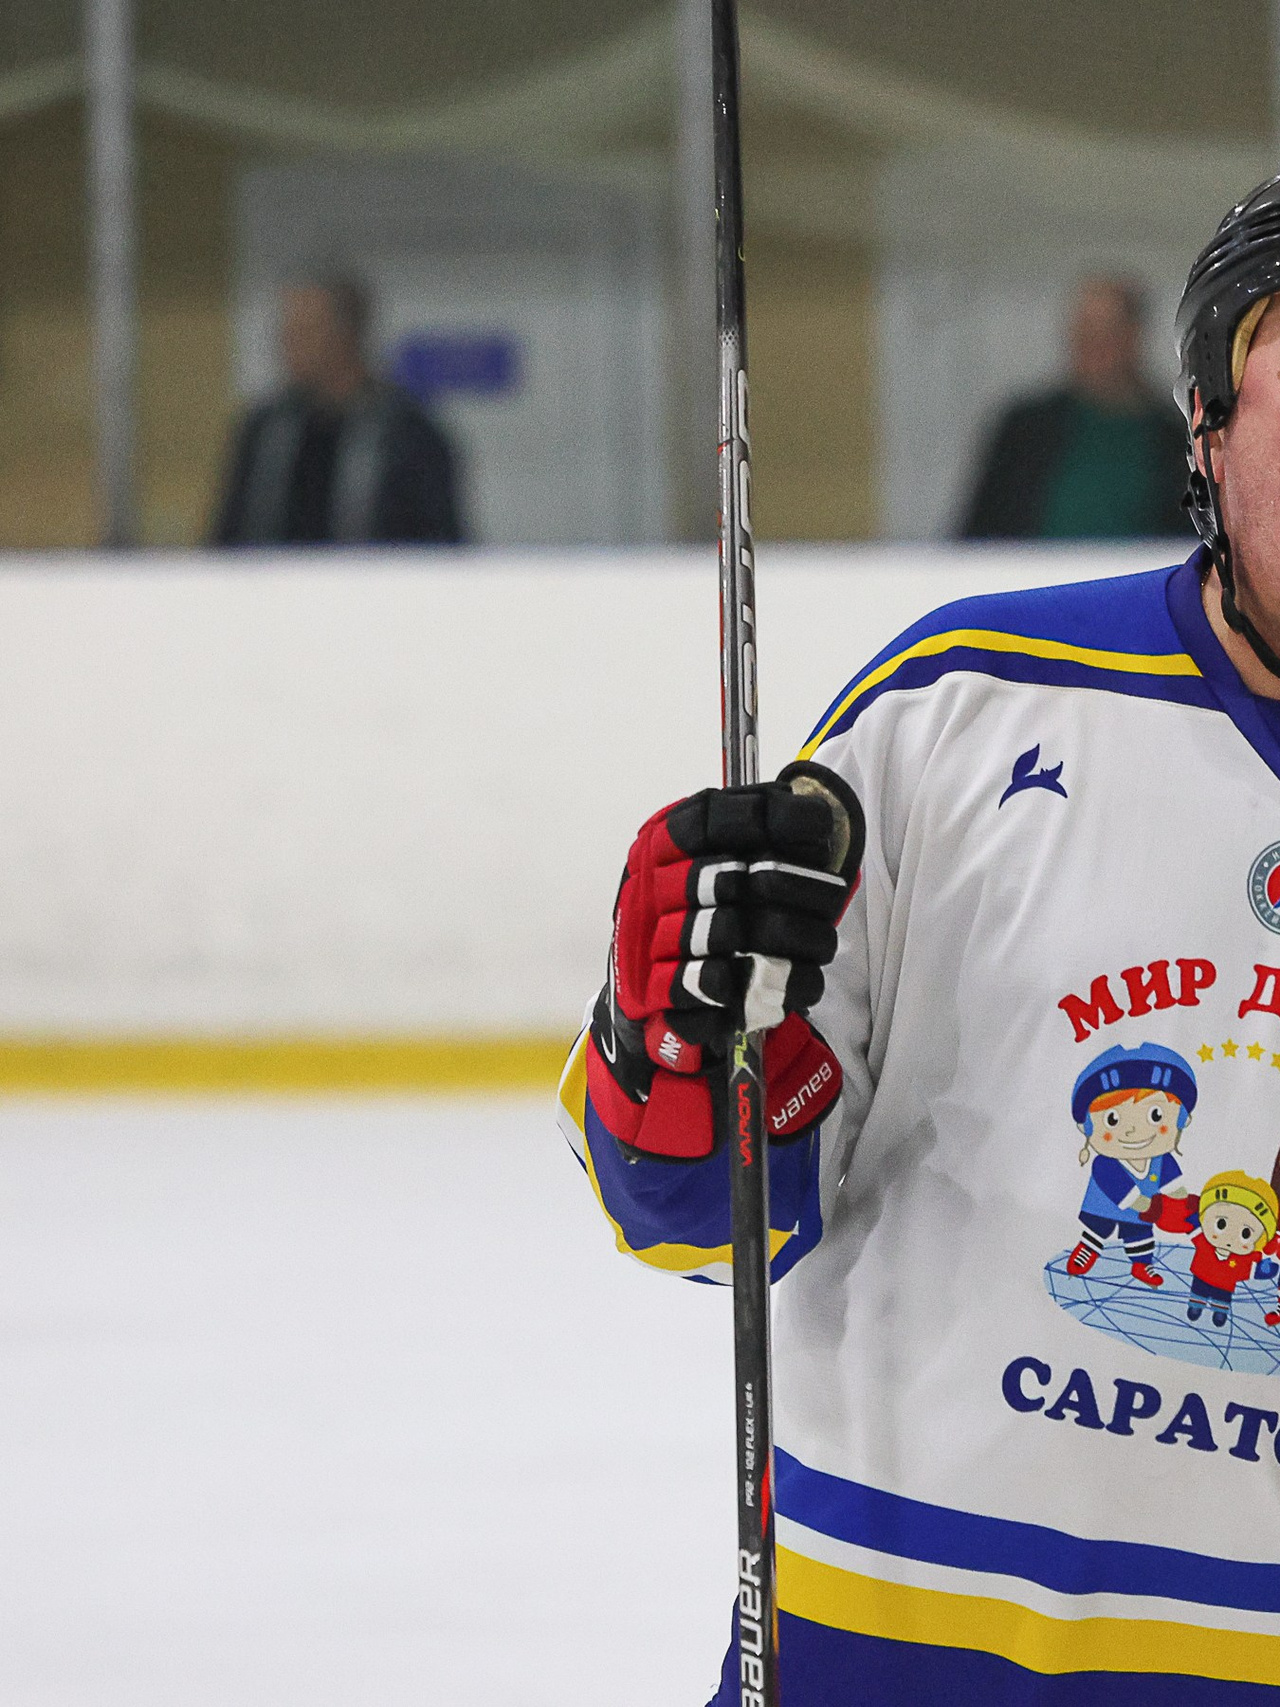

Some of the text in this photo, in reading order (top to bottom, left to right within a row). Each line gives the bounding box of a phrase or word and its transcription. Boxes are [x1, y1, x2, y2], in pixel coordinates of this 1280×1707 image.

[1057, 957, 1217, 1043] МИР
[737, 1083, 753, 1168] VAPOR
[771, 1062, 833, 1130] BAUER
